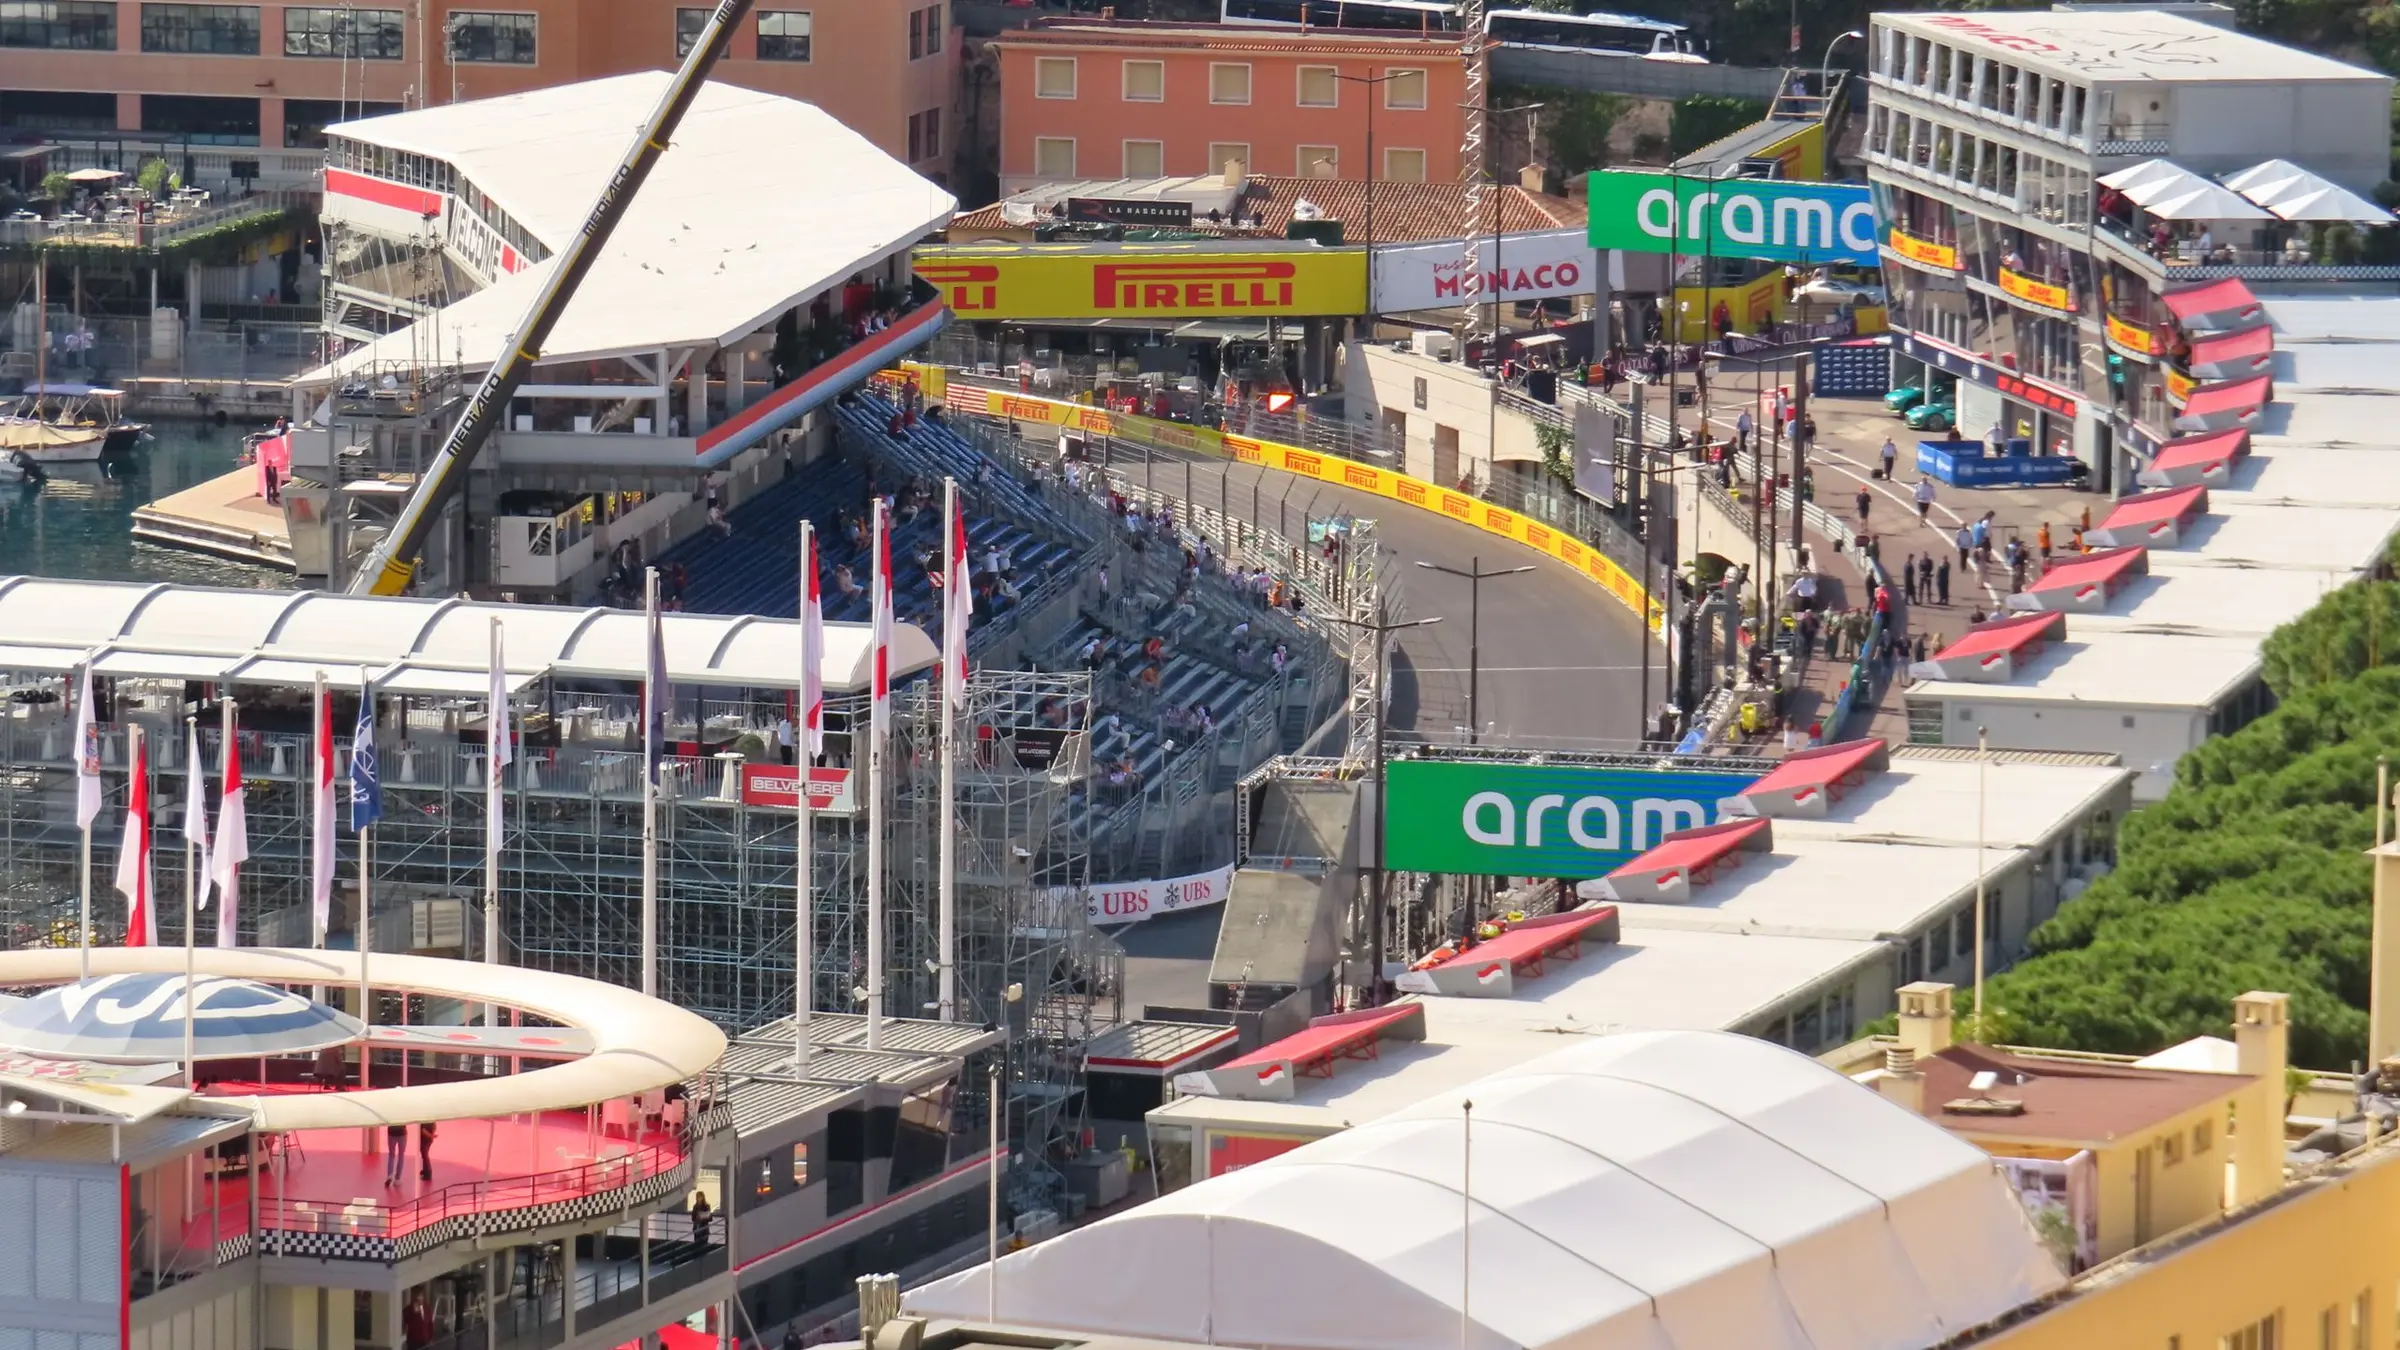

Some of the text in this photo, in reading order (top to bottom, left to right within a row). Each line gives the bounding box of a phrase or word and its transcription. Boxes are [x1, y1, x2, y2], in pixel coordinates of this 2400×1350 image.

[1637, 189, 1876, 251] aramc
[450, 201, 501, 284] WELCOME
[1094, 262, 1296, 308] PIRELLI
[1434, 263, 1579, 298] MONACO
[1003, 397, 1049, 421] PIRELLI
[1285, 451, 1321, 476] PIRELLI
[1345, 464, 1377, 489] PIRELLI
[1397, 480, 1425, 505] PIRELLI
[1462, 791, 1722, 851] aram
[1102, 889, 1149, 915] UBS
[1184, 879, 1211, 902] UBS
